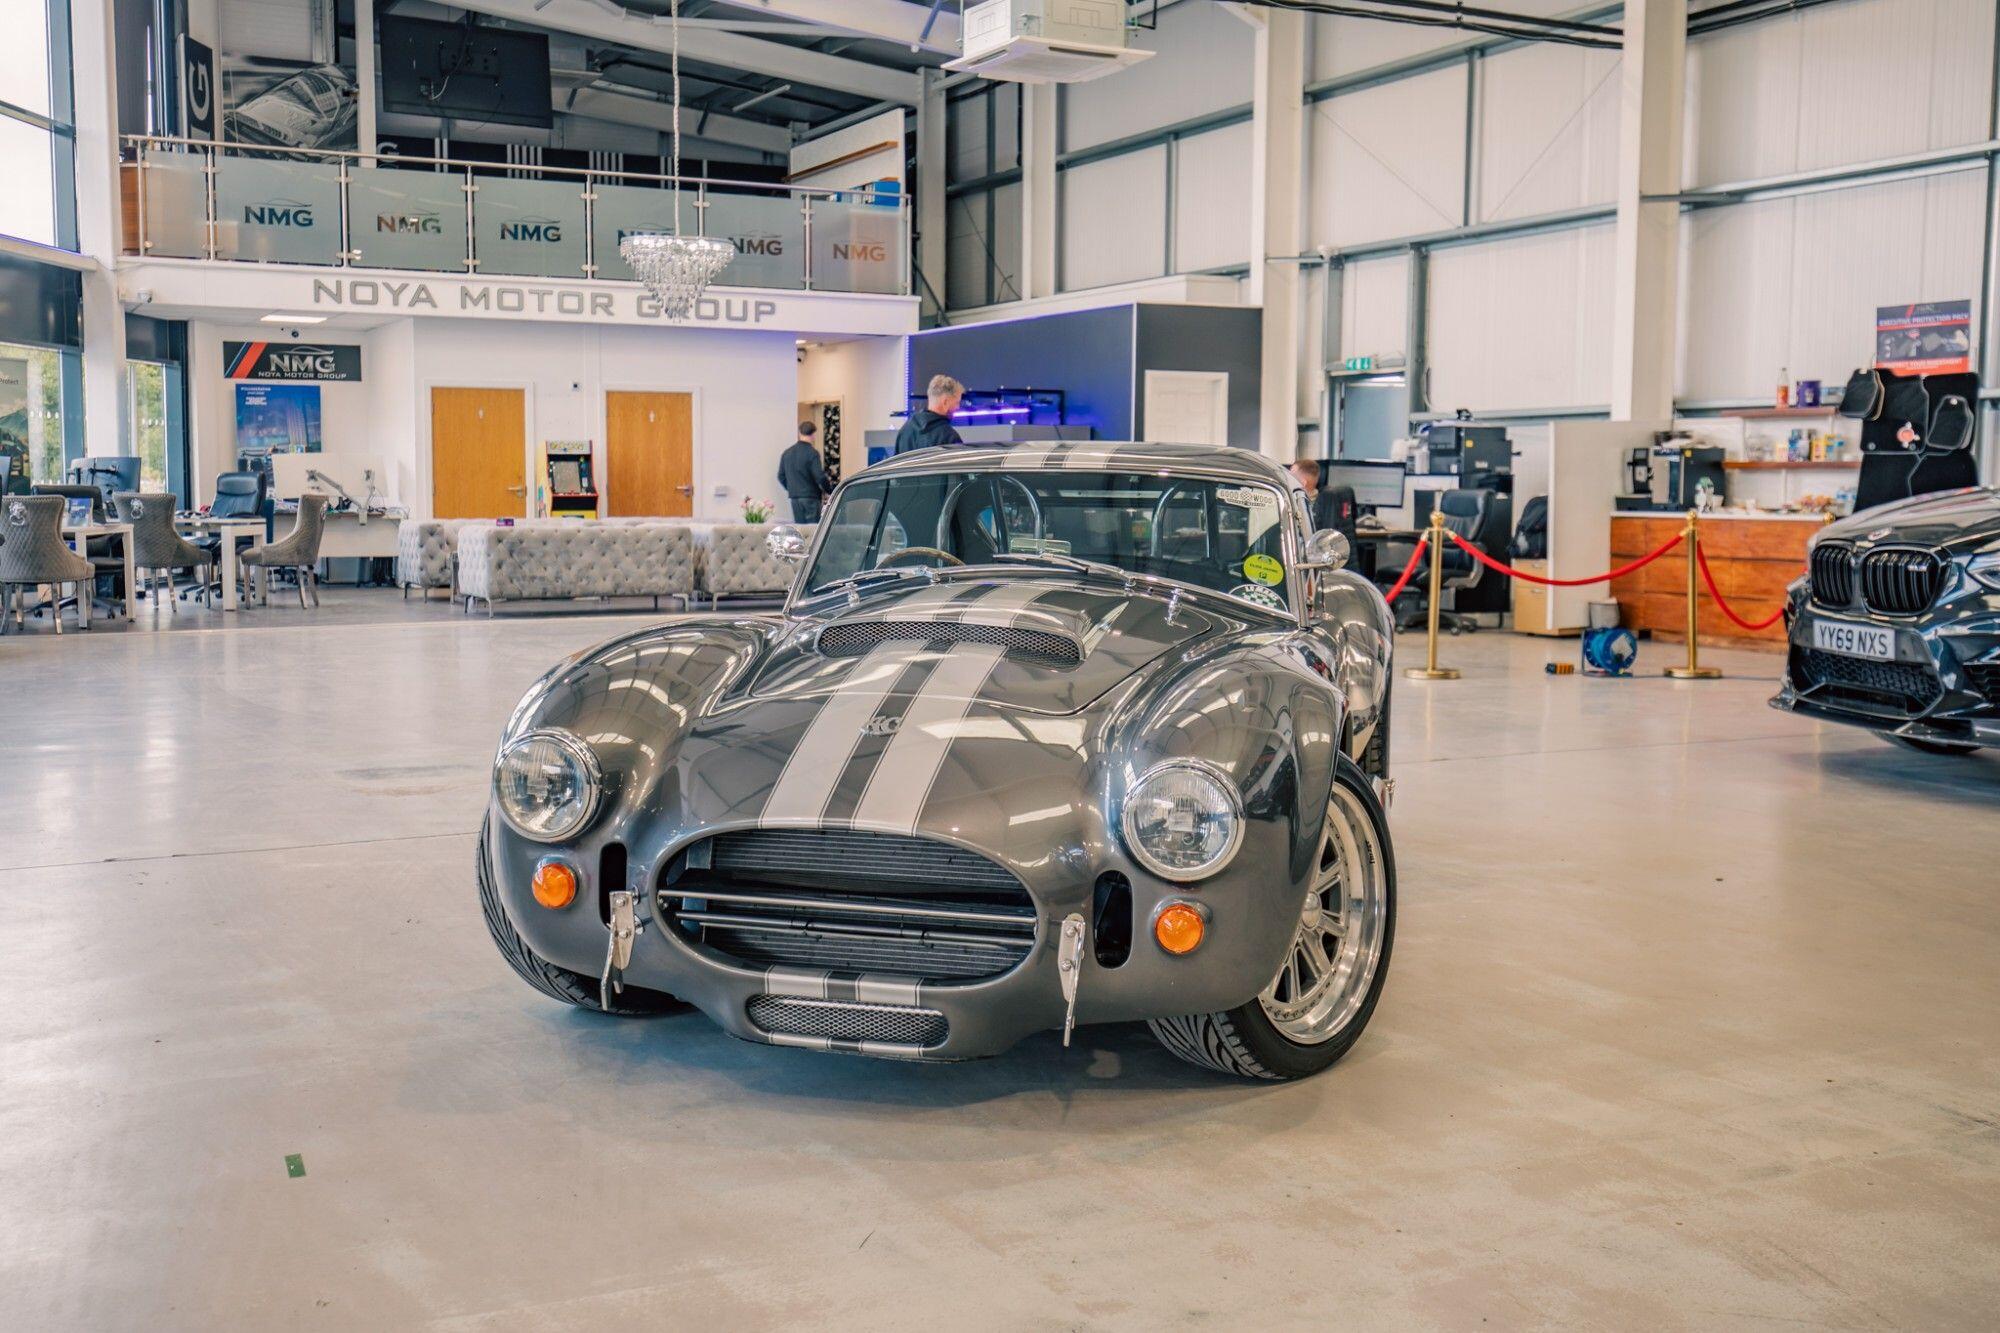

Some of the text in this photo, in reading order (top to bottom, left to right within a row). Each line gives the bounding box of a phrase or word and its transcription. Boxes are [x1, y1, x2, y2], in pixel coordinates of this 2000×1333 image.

[245, 206, 314, 227] NMG
[377, 214, 442, 234] NMG
[501, 223, 562, 243] NMG
[728, 236, 784, 257] NMG
[833, 243, 886, 262] NMG
[313, 278, 438, 309] NOYA
[460, 285, 615, 316] MOTOR
[269, 354, 335, 373] NMG
[1820, 625, 1888, 656] YY69 NXS
